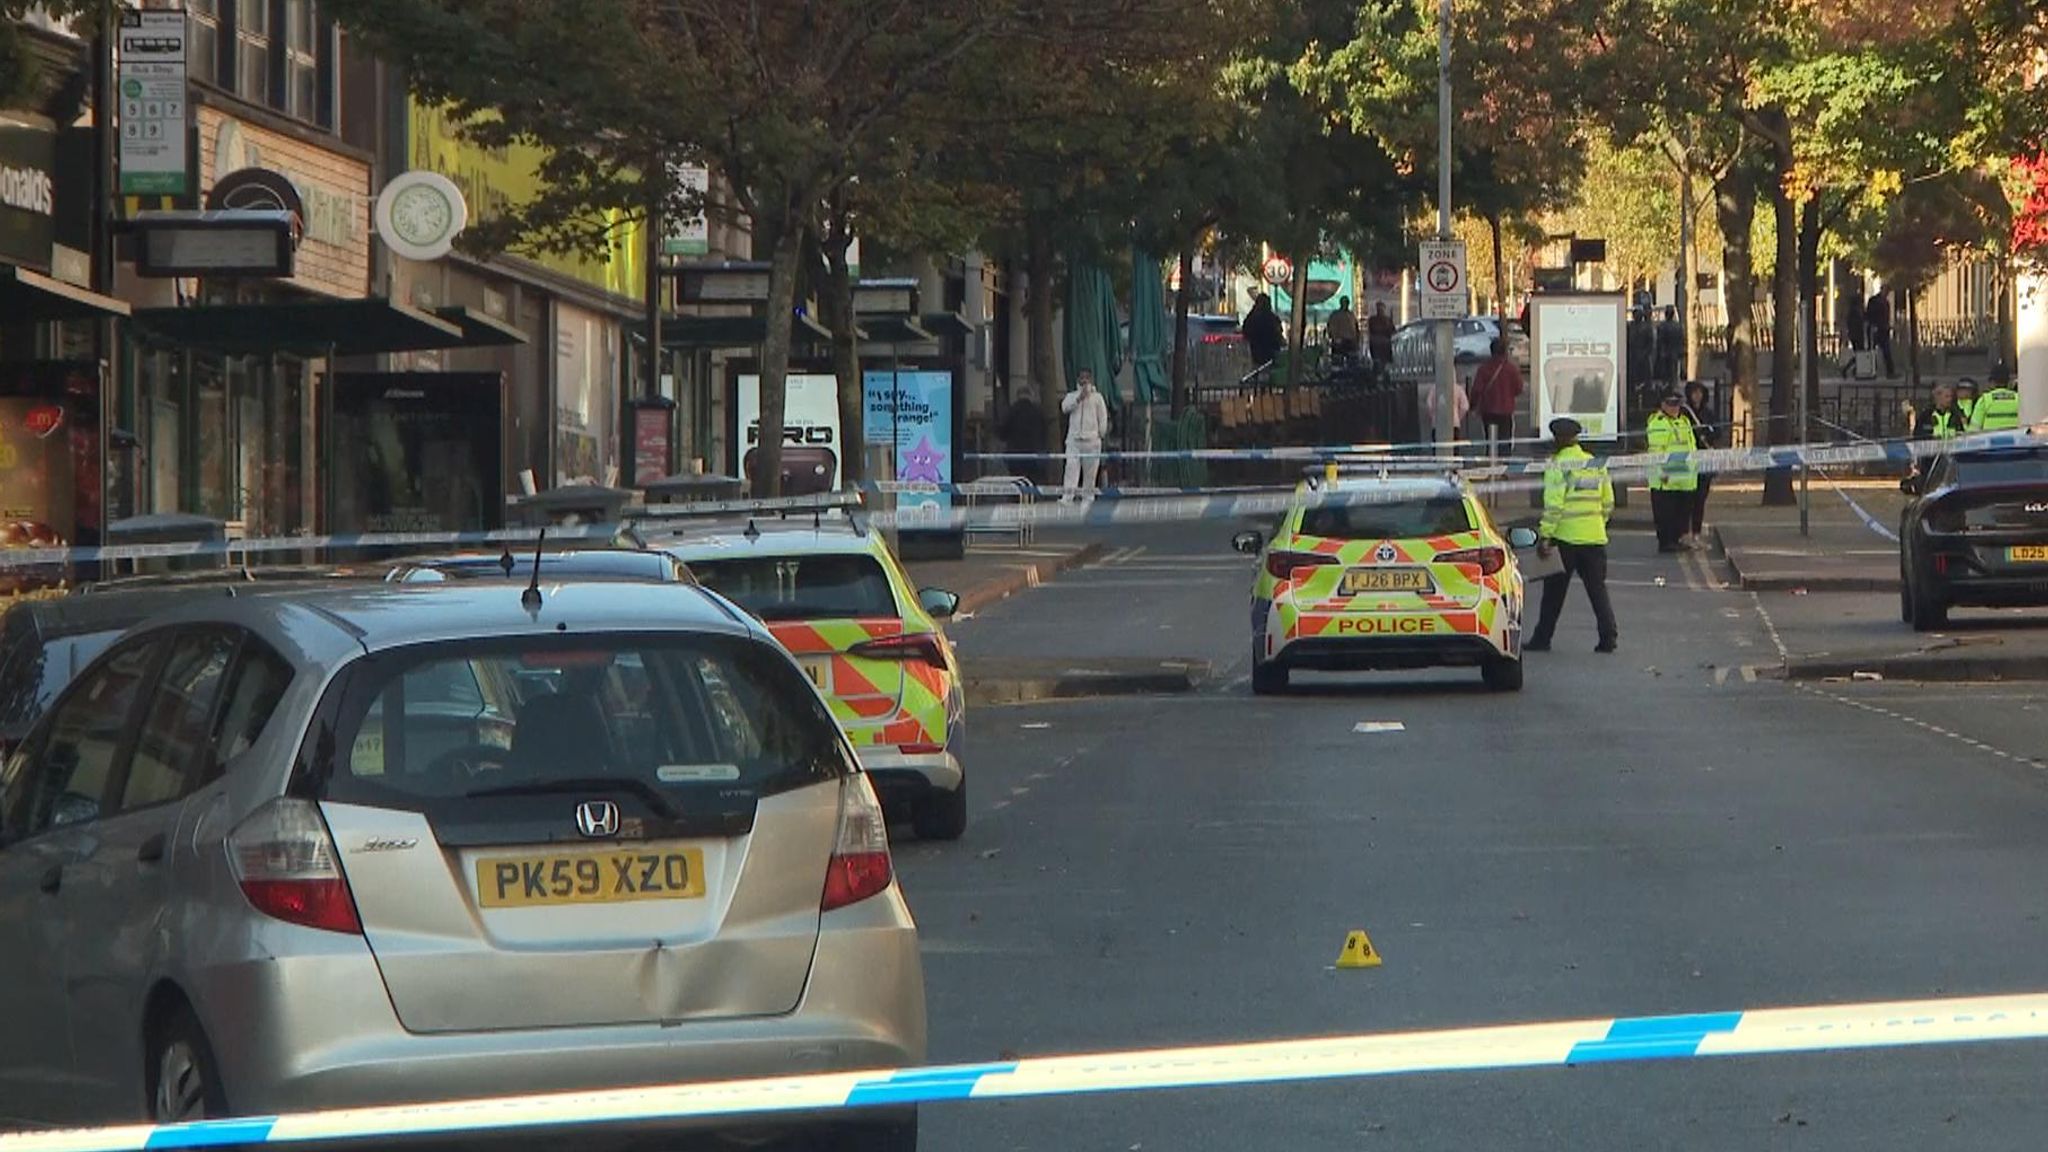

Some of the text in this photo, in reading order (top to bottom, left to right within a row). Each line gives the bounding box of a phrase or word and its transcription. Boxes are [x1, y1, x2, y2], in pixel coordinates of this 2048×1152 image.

[149, 124, 157, 136] 9
[0, 165, 53, 215] onald's
[1428, 250, 1456, 259] ZONE
[1268, 266, 1287, 278] 30
[1547, 343, 1610, 355] PRO
[870, 401, 929, 413] somthing
[895, 411, 938, 424] range!”
[2012, 548, 2045, 559] LD25
[1351, 571, 1421, 588] FJ26 BPX
[1338, 618, 1435, 633] POLICE
[496, 859, 600, 899] PK59
[1363, 944, 1371, 957] 8
